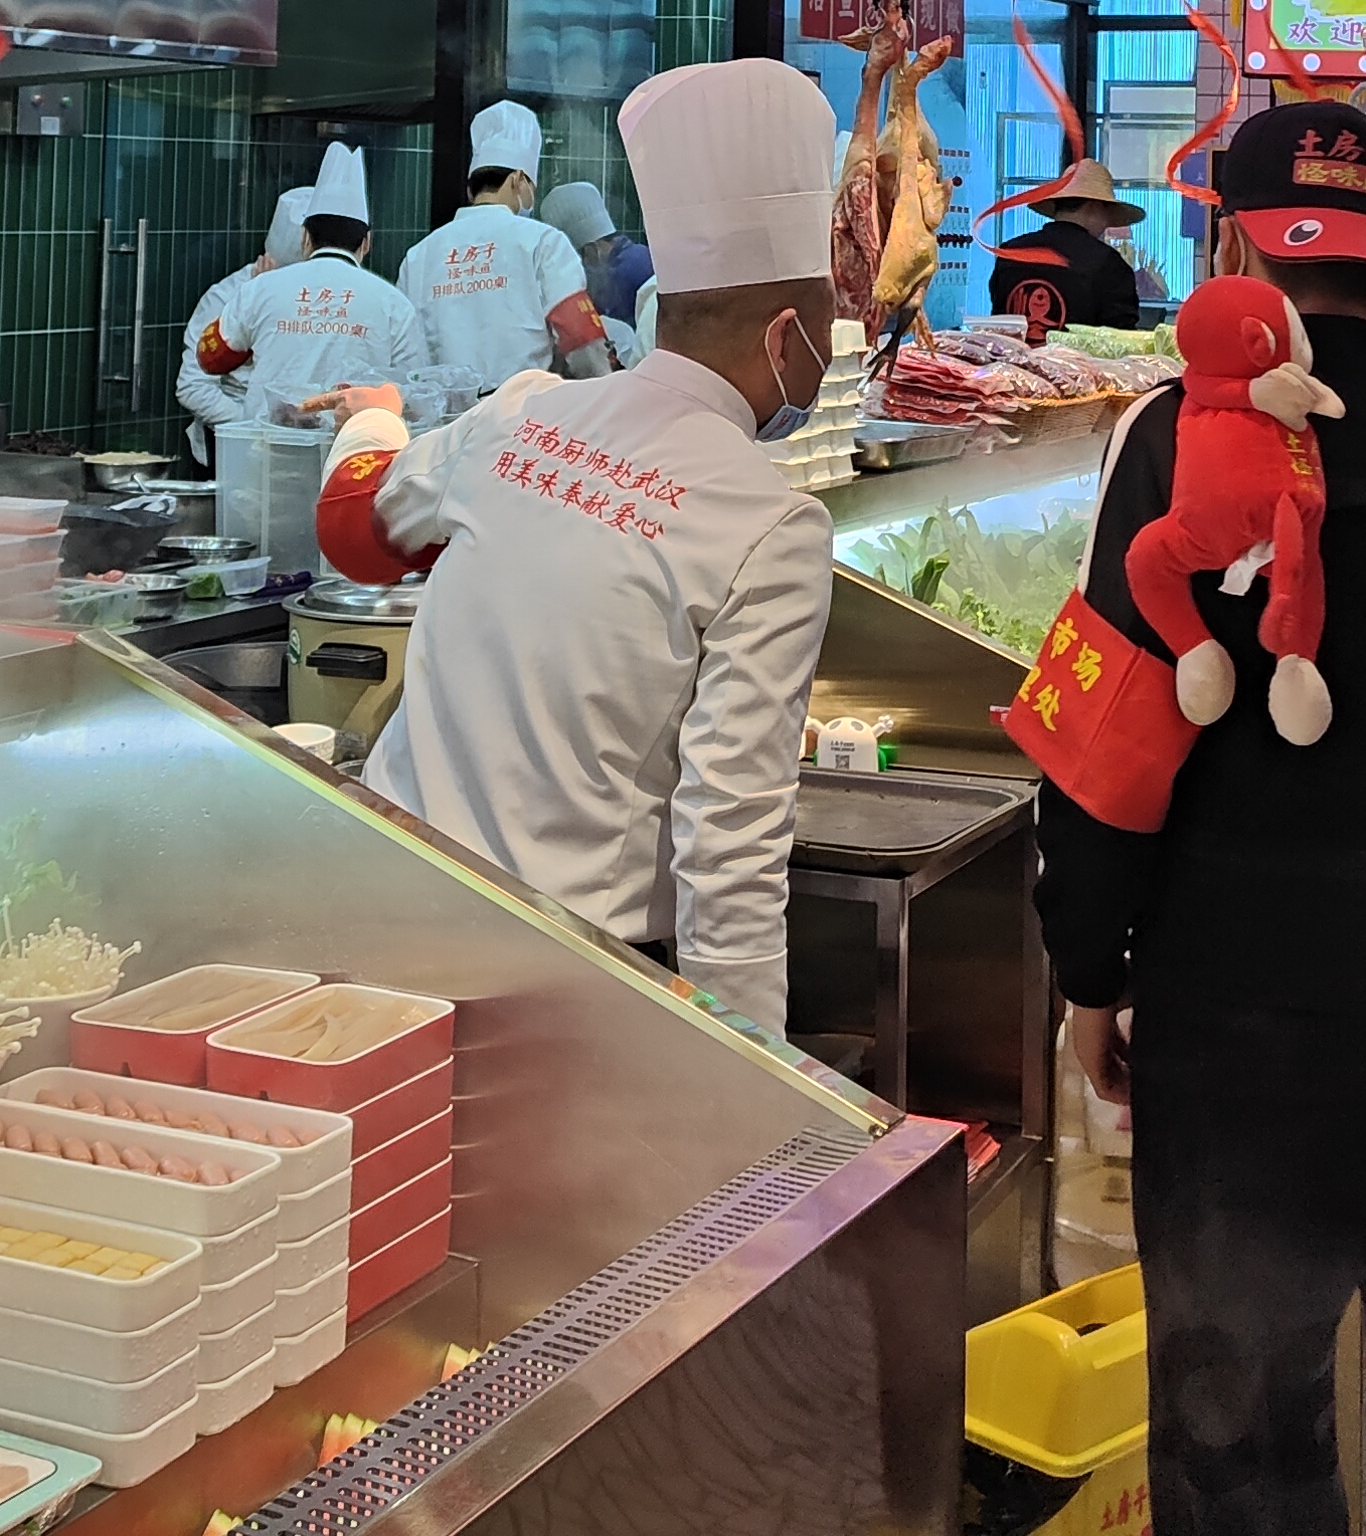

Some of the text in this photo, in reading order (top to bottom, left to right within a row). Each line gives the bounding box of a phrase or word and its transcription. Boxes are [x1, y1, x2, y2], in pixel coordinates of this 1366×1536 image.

[444, 242, 497, 265] 土房子
[294, 286, 356, 305] 土房子
[512, 417, 688, 511] 河南厨师赴武汉
[489, 450, 665, 540] 用美味奉献爱心
